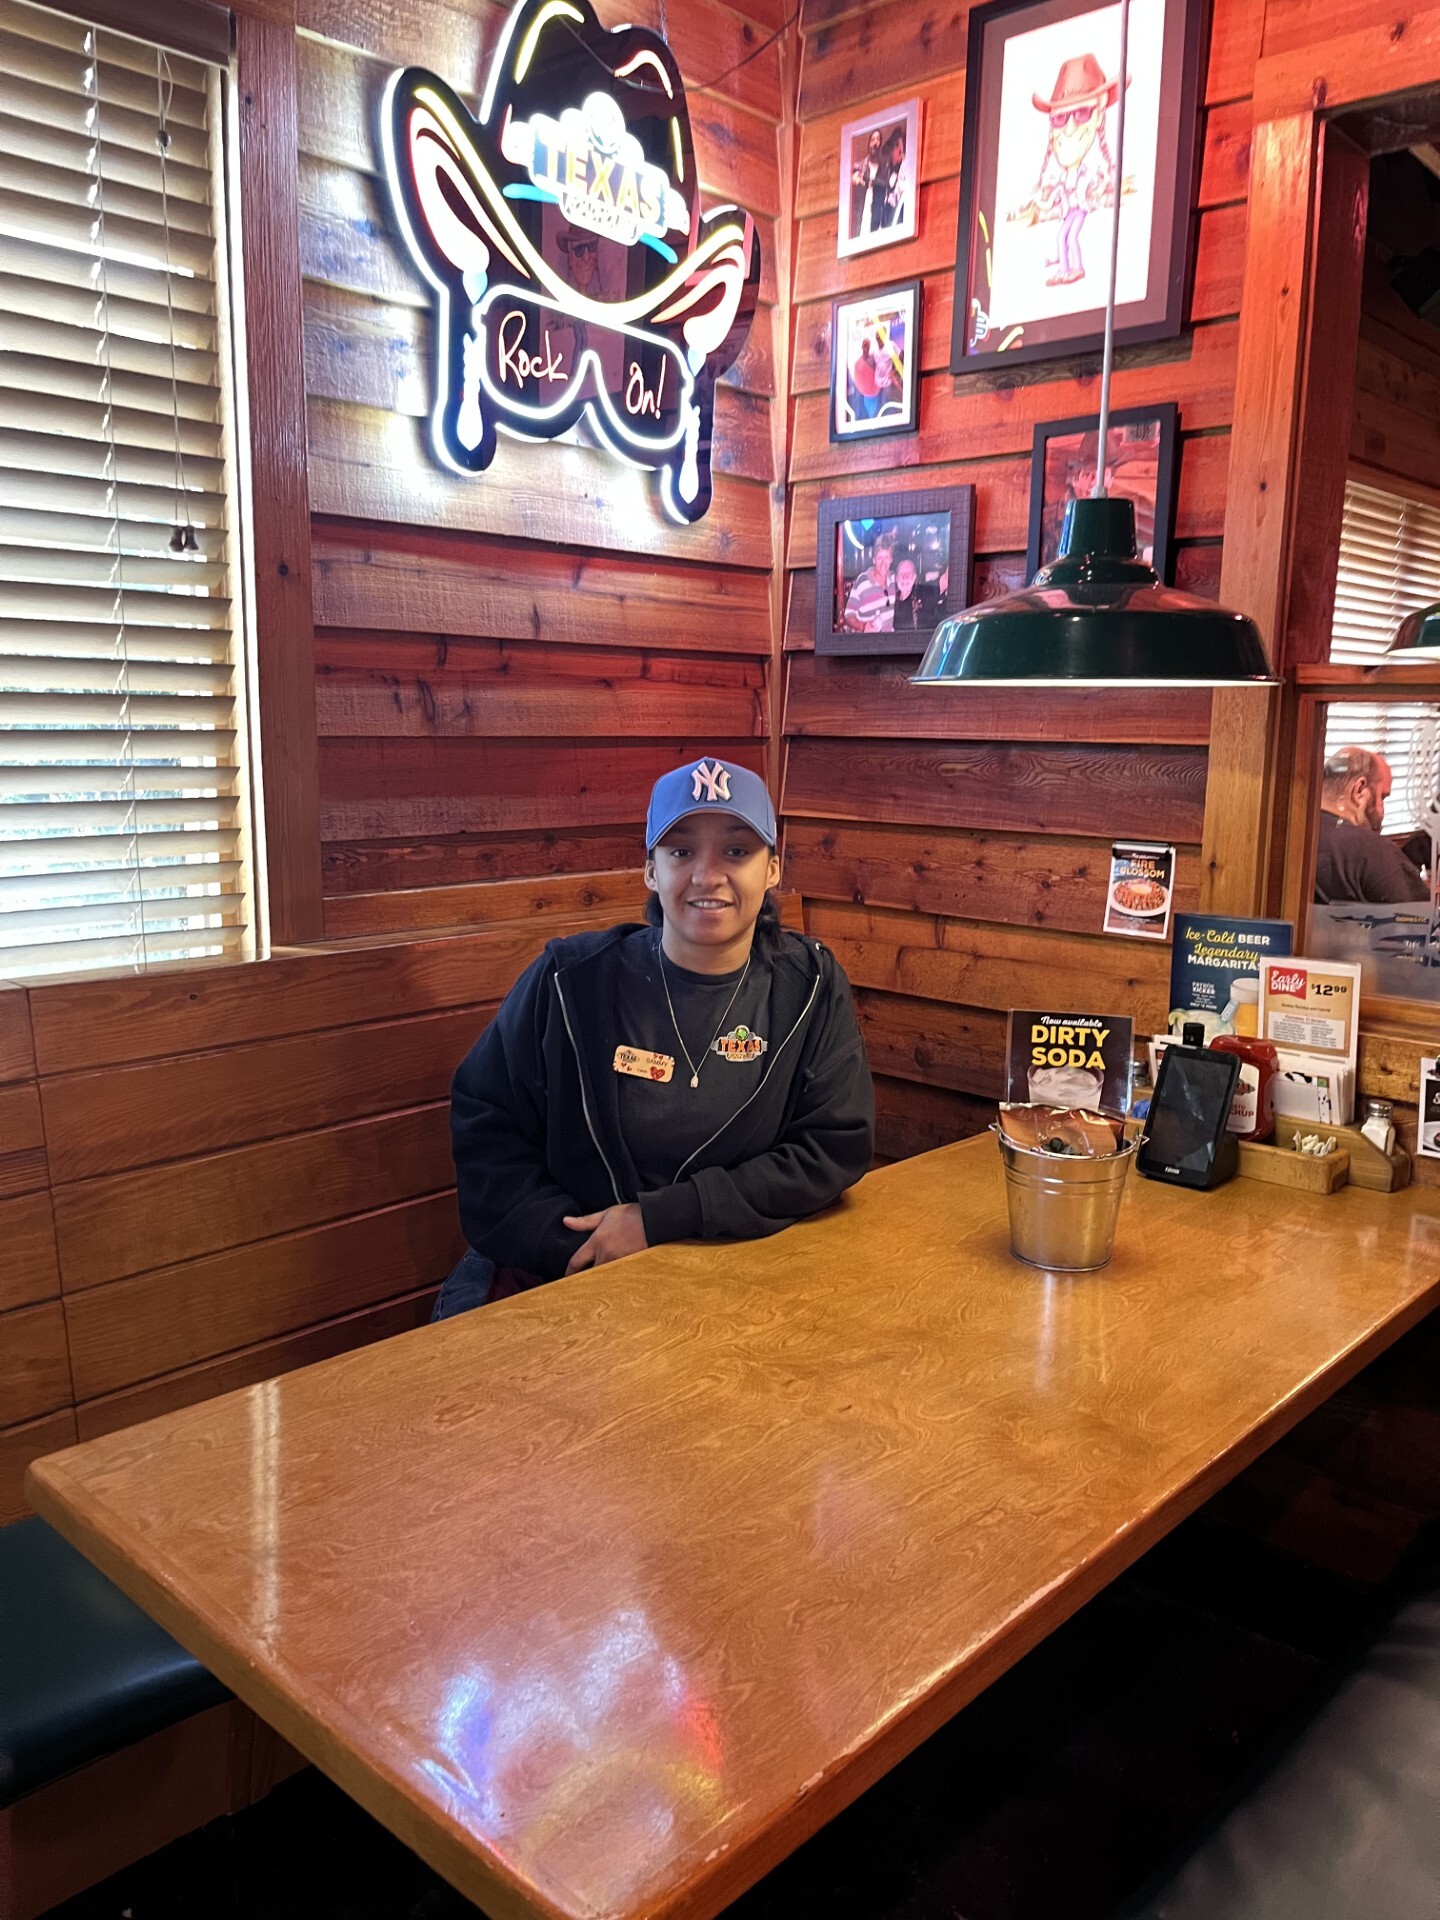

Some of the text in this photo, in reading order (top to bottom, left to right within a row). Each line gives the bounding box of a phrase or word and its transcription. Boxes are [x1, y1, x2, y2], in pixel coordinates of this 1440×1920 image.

[537, 126, 663, 223] TEXAS
[498, 310, 667, 419] Rock On!
[691, 761, 731, 801] NY
[1120, 866, 1165, 879] BLOSSOM
[1131, 860, 1155, 870] FIRE
[1185, 926, 1271, 946] Ice-Cold BEER
[1194, 942, 1259, 961] Legendary
[1271, 970, 1306, 989] Early
[1271, 981, 1297, 993] DINE
[1040, 1016, 1103, 1028] Now available
[721, 1039, 760, 1052] TEXAS
[1031, 1025, 1110, 1047] DIRTY
[1031, 1047, 1106, 1070] SODA
